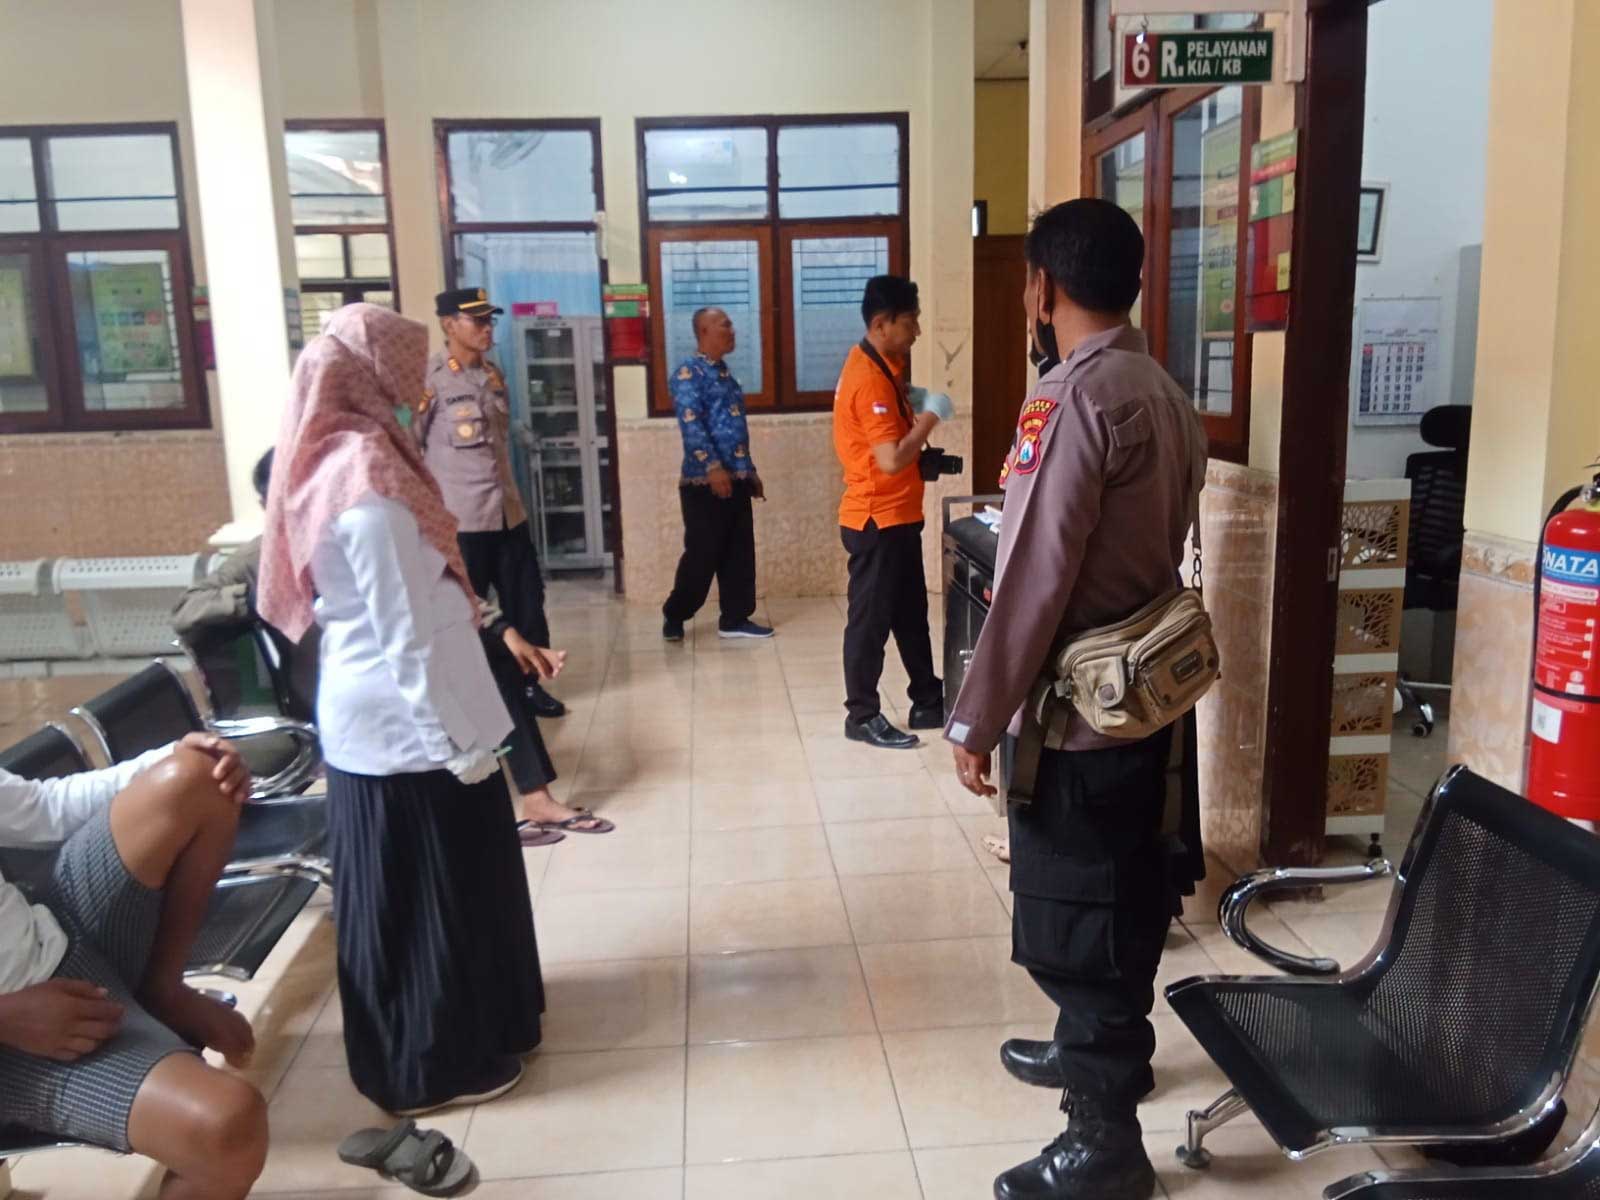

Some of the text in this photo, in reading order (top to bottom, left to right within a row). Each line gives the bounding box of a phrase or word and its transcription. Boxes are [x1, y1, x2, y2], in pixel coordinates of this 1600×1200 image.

[1132, 42, 1150, 78] 6
[1161, 41, 1184, 77] R.
[1187, 40, 1267, 57] PELAYANAN
[1187, 60, 1211, 76] KIA
[1222, 59, 1242, 75] KB
